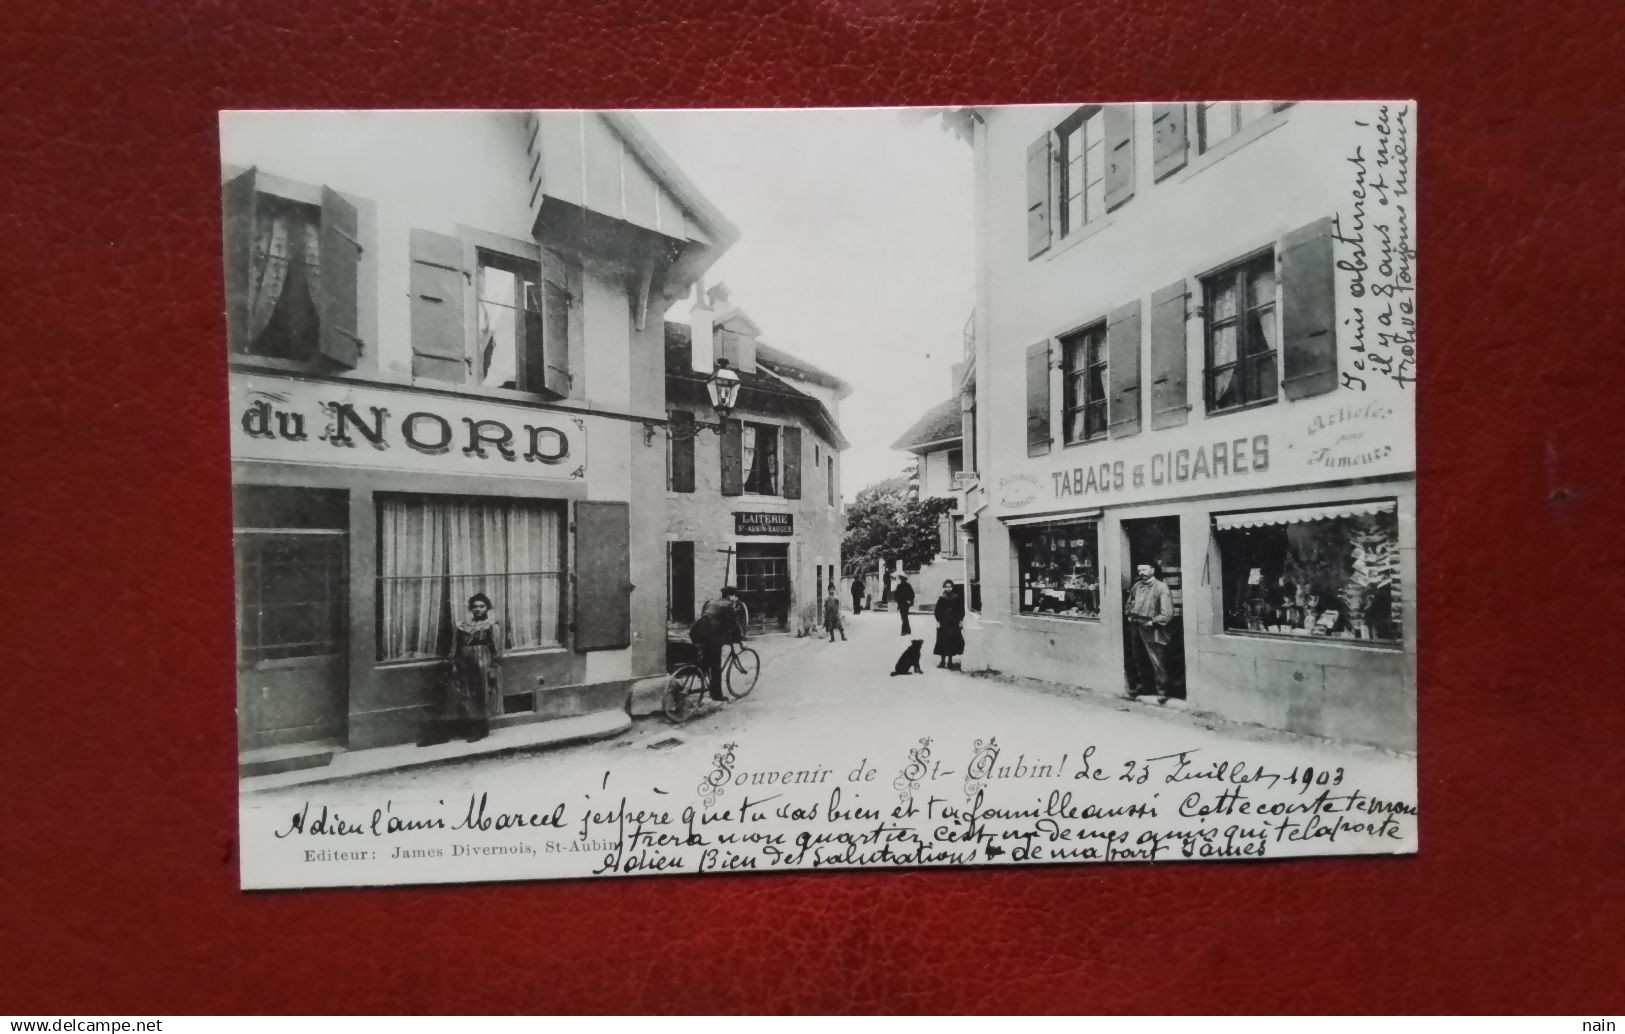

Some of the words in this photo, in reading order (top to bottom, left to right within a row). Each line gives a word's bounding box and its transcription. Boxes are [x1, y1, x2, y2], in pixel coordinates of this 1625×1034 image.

[1370, 283, 1394, 299] 8
[241, 399, 308, 442] du
[318, 400, 570, 466] NORD
[1051, 459, 1126, 499] TABACS
[1132, 464, 1147, 489] &
[1151, 434, 1270, 487] CIGARES
[742, 514, 788, 524] LAITERIE
[697, 741, 832, 808] Souvenir
[848, 757, 877, 783] de
[1075, 745, 1111, 781] Le
[1282, 765, 1345, 795] 1903
[274, 800, 365, 839] Adieu
[451, 791, 569, 832] Marcel
[827, 786, 881, 823] bien
[890, 796, 920, 819] et
[961, 788, 1078, 838] famille
[1081, 792, 1159, 820] aussi
[1178, 785, 1251, 818] Cette
[303, 849, 377, 863] Editeur:
[391, 845, 444, 861] James
[451, 842, 538, 858] Divernois,
[592, 845, 685, 875] Adieu
